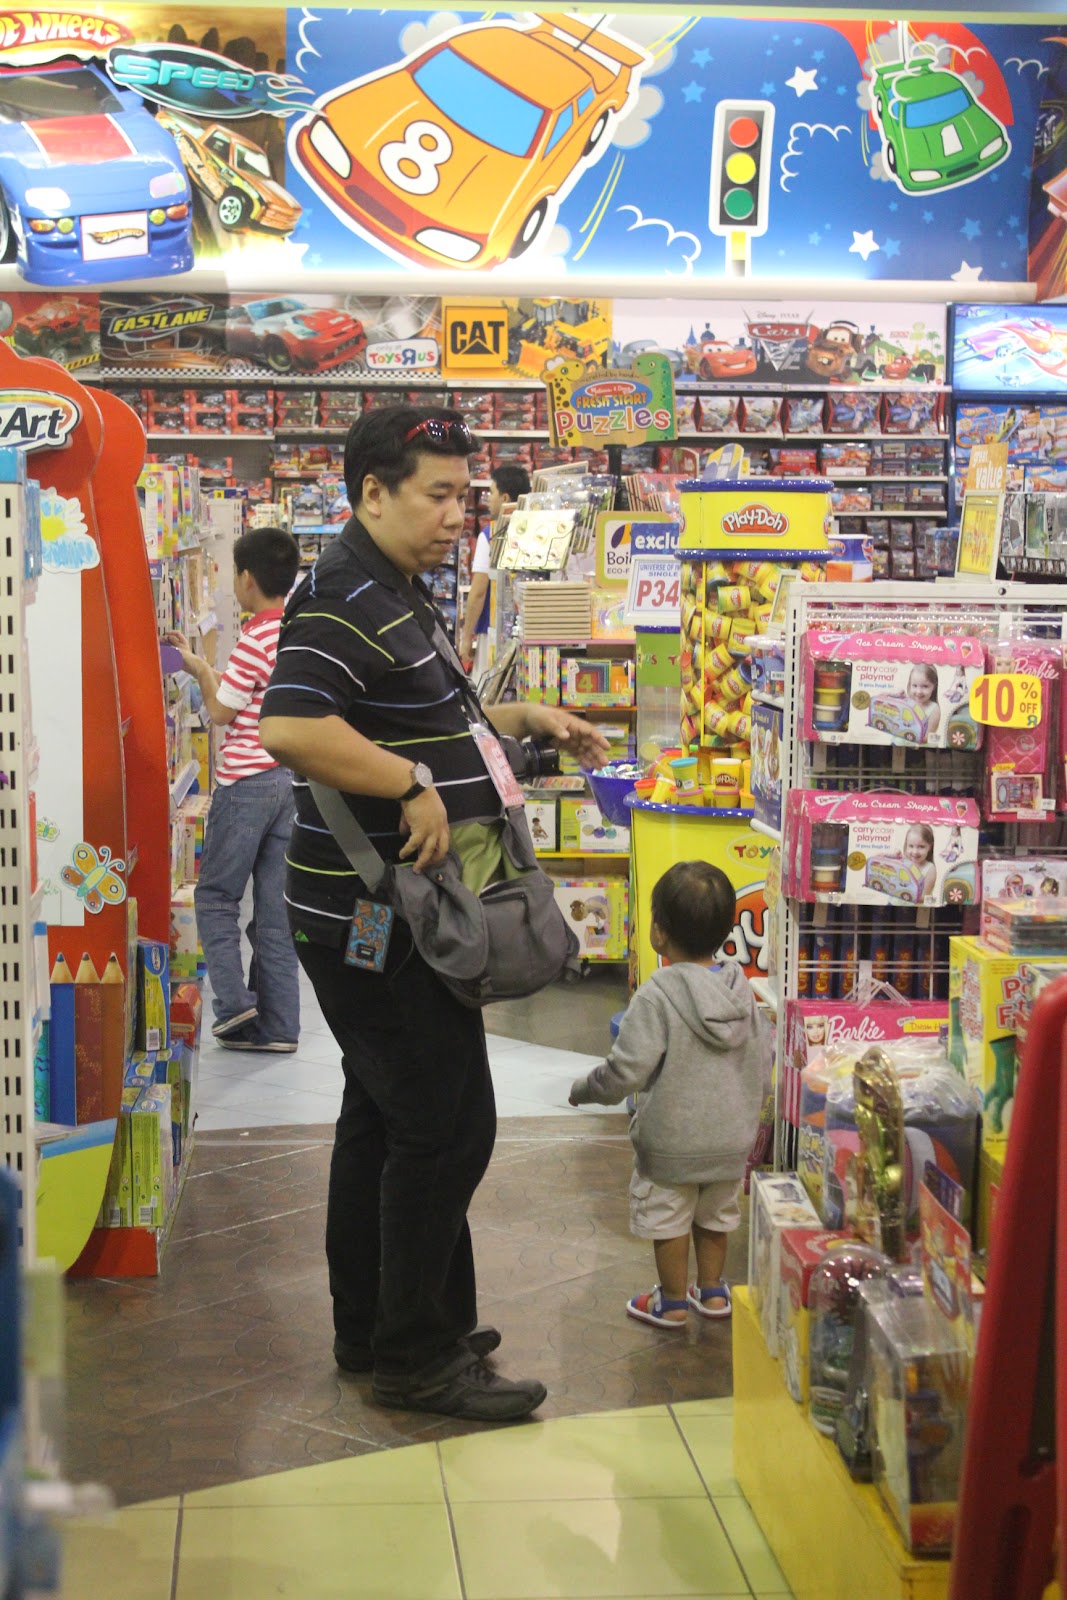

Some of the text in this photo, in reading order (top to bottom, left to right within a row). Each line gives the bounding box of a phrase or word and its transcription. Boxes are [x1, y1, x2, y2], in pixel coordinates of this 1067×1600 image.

[114, 54, 255, 91] SPEED
[378, 119, 453, 195] 8
[450, 320, 505, 355] CAT
[752, 324, 801, 337] Cars
[0, 407, 64, 439] Art
[975, 460, 1003, 489] value
[723, 508, 784, 532] Play-Doh
[607, 551, 632, 565] Boi
[636, 579, 681, 607] P34
[856, 638, 872, 647] Ice
[874, 638, 905, 648] Cream
[908, 640, 944, 652] Shoppe
[856, 665, 878, 674] carry
[860, 672, 895, 682] playmat
[1014, 657, 1060, 679] Barbie
[1019, 702, 1038, 714] OFF
[852, 799, 868, 808] Ice
[870, 799, 901, 809] Cream
[904, 801, 940, 812] Shoppe
[853, 826, 875, 835] carry
[856, 834, 891, 842] playmat
[828, 1015, 886, 1045] Barbie
